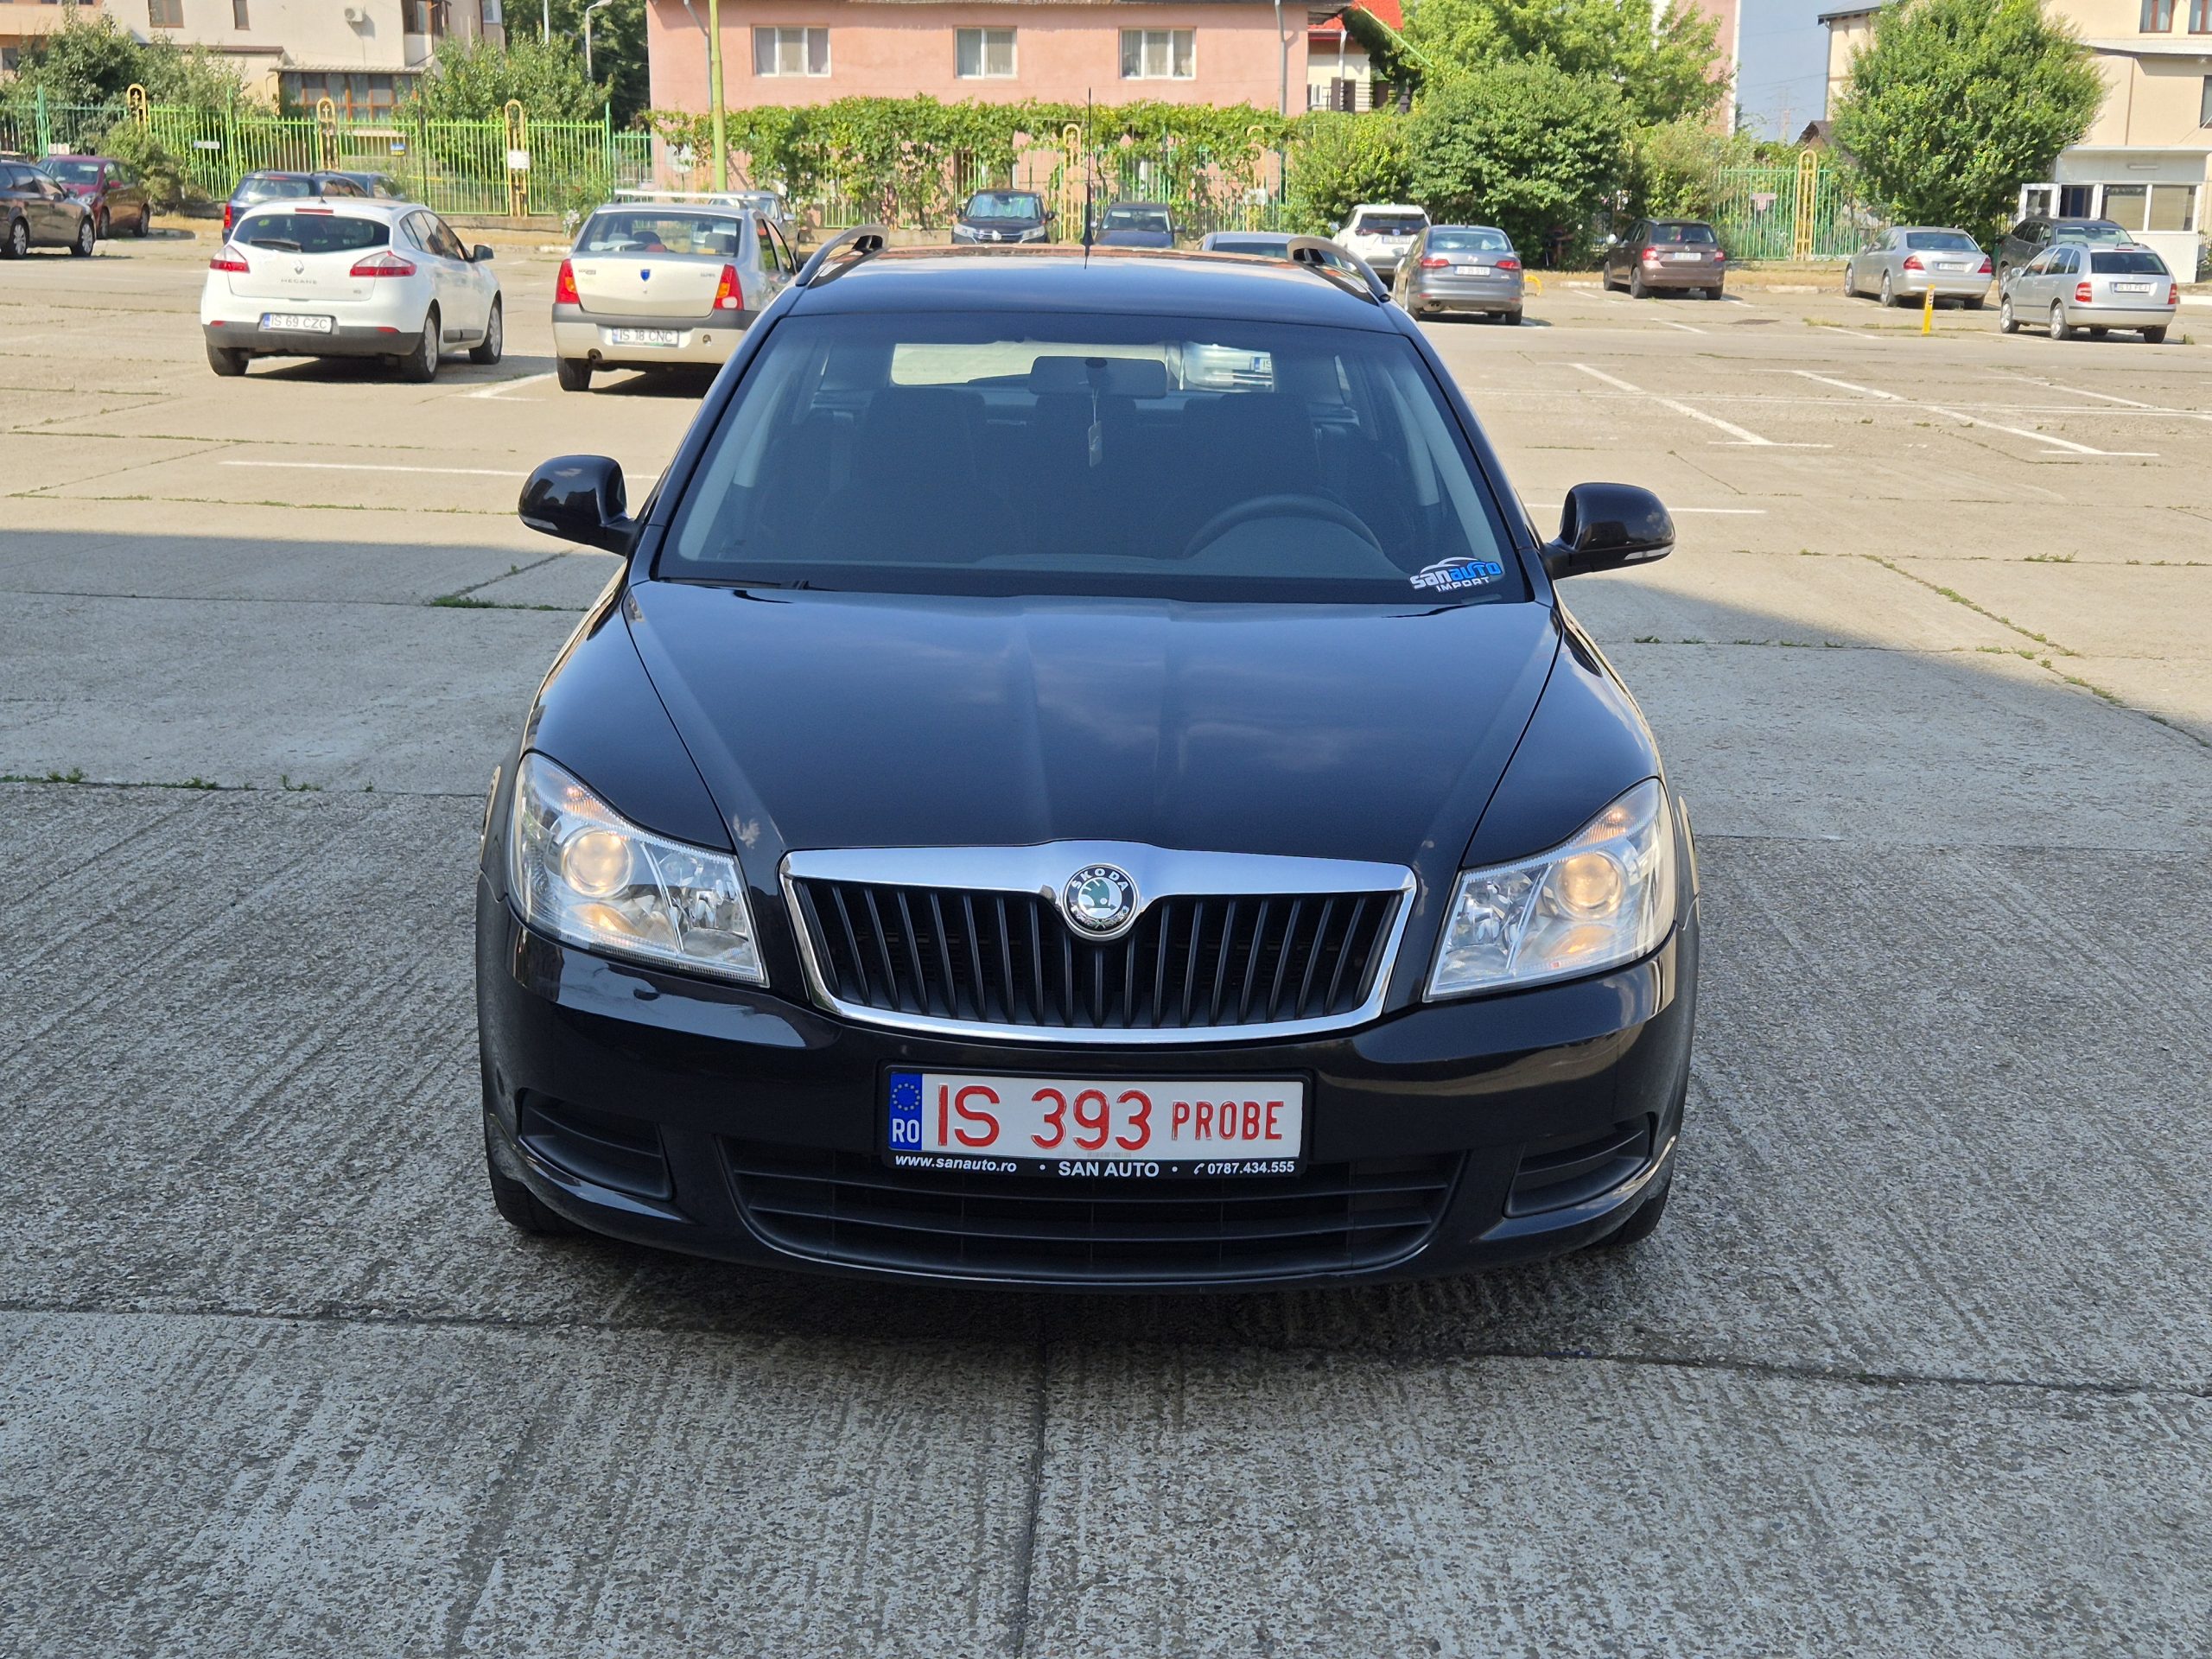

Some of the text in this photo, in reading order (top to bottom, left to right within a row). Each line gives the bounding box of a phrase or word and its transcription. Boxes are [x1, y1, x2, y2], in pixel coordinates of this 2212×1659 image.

[302, 318, 327, 329] CZC
[620, 328, 630, 340] IS
[649, 331, 672, 342] CNC
[1435, 576, 1490, 593] IMPORT
[891, 1084, 1285, 1151] RO IS 393 PROBE
[895, 1154, 1296, 1178] www.sanauto.ro SAN AUTO 0787.434.555
